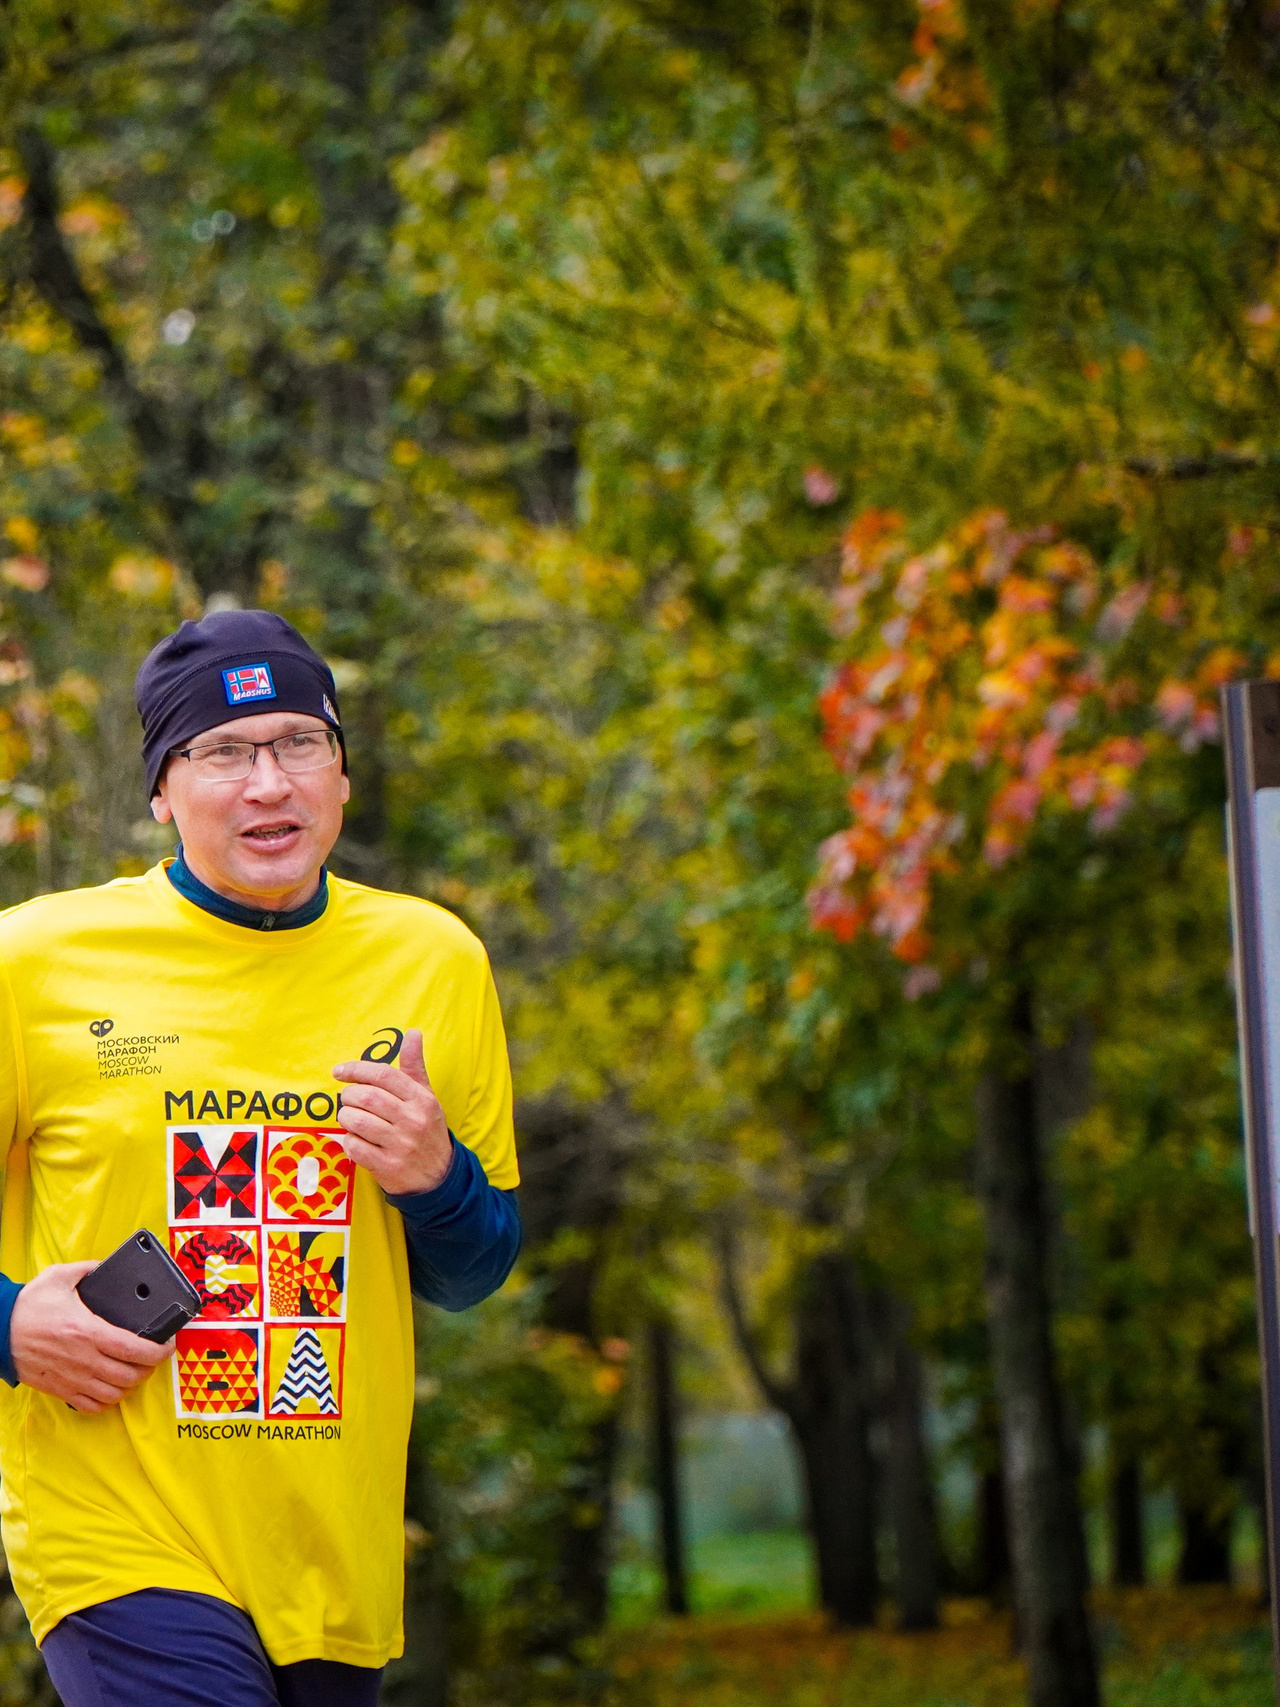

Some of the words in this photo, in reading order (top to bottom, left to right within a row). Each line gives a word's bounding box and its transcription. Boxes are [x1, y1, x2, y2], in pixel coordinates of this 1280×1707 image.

[233, 688, 272, 701] MADSHUS
[97, 1034, 180, 1049] МОСКОВСКИЙ
[97, 1046, 157, 1060] МАРАФОН
[98, 1056, 150, 1070] MOSCOW
[99, 1065, 162, 1080] MARATHON
[177, 1424, 252, 1440] MOSCOW
[257, 1425, 341, 1440] MARATHON
